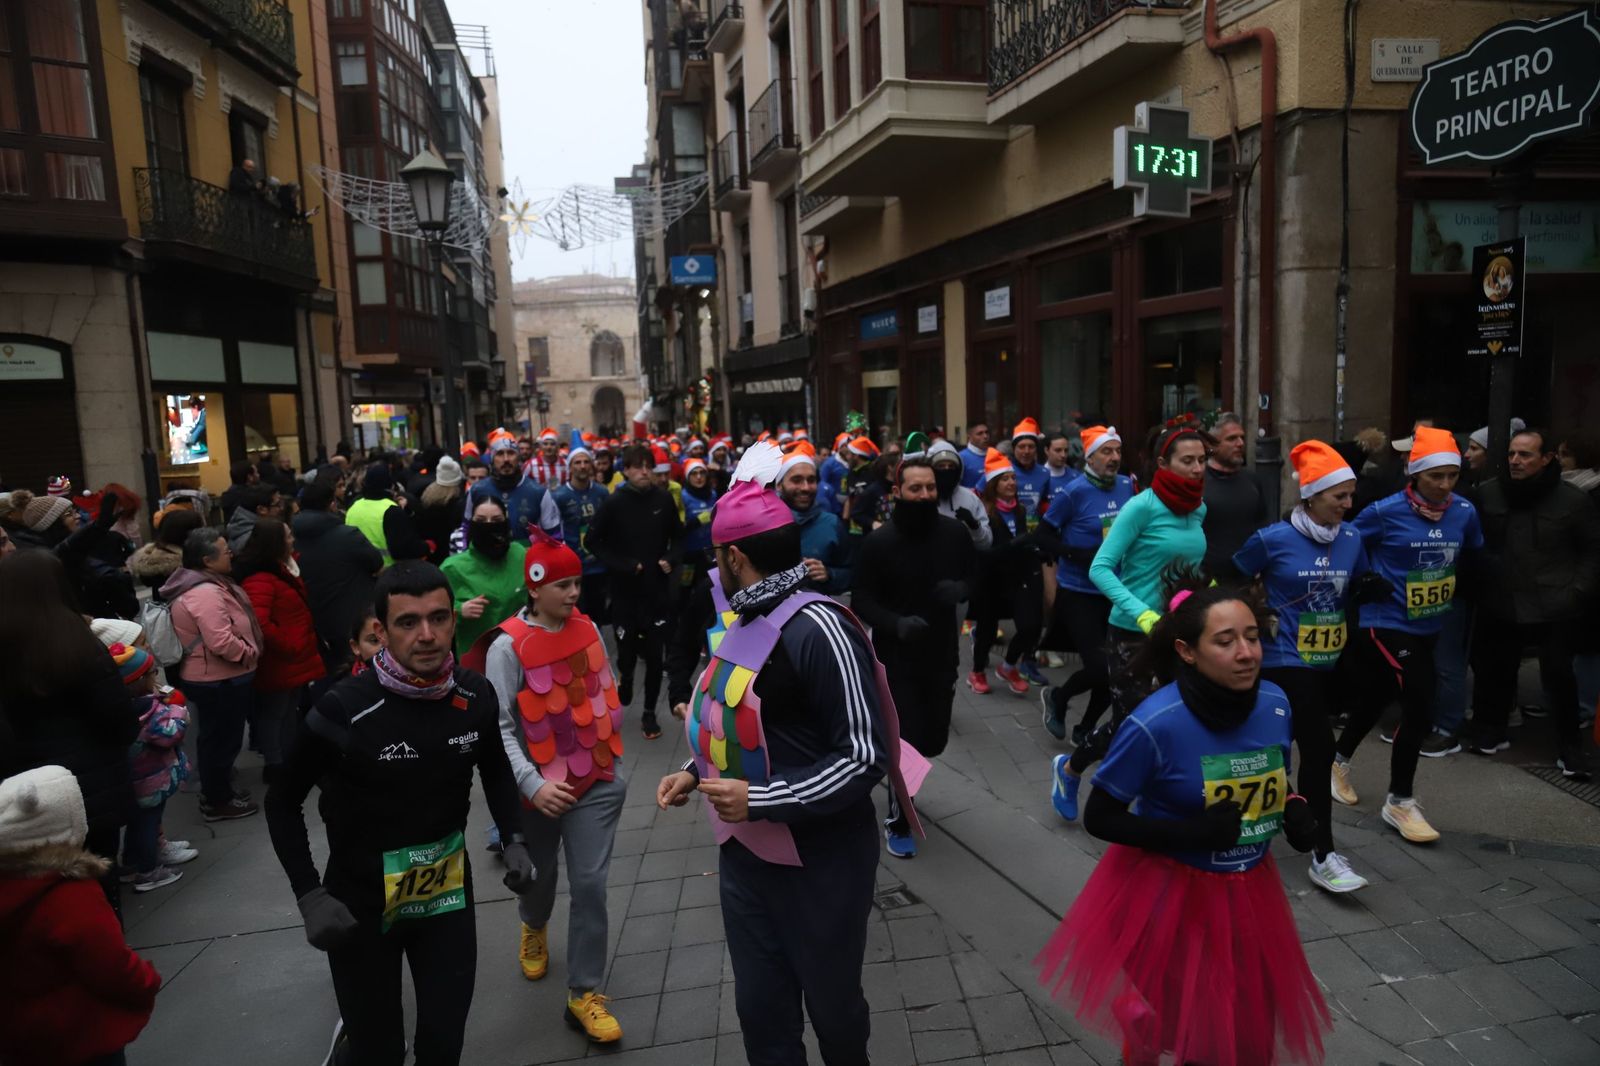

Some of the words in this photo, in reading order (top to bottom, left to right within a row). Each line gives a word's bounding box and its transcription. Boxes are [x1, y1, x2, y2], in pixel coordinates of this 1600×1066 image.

[1396, 45, 1424, 54] CALLE
[1401, 56, 1414, 65] DE
[1376, 67, 1423, 77] QUEBRANTAHU
[1450, 47, 1554, 101] TEATRO
[1435, 84, 1572, 144] PRINCIPAL
[1134, 144, 1198, 178] 17:31
[1455, 213, 1472, 226] Un
[1530, 210, 1541, 225] la
[1545, 209, 1581, 226] salud
[1481, 231, 1496, 242] de
[1428, 529, 1443, 539] 46
[1314, 556, 1330, 567] 46
[1411, 583, 1450, 606] 556
[1304, 628, 1342, 648] 413
[1254, 820, 1278, 835] RURAL
[401, 903, 425, 914] CAJA
[428, 895, 460, 911] RURAL
